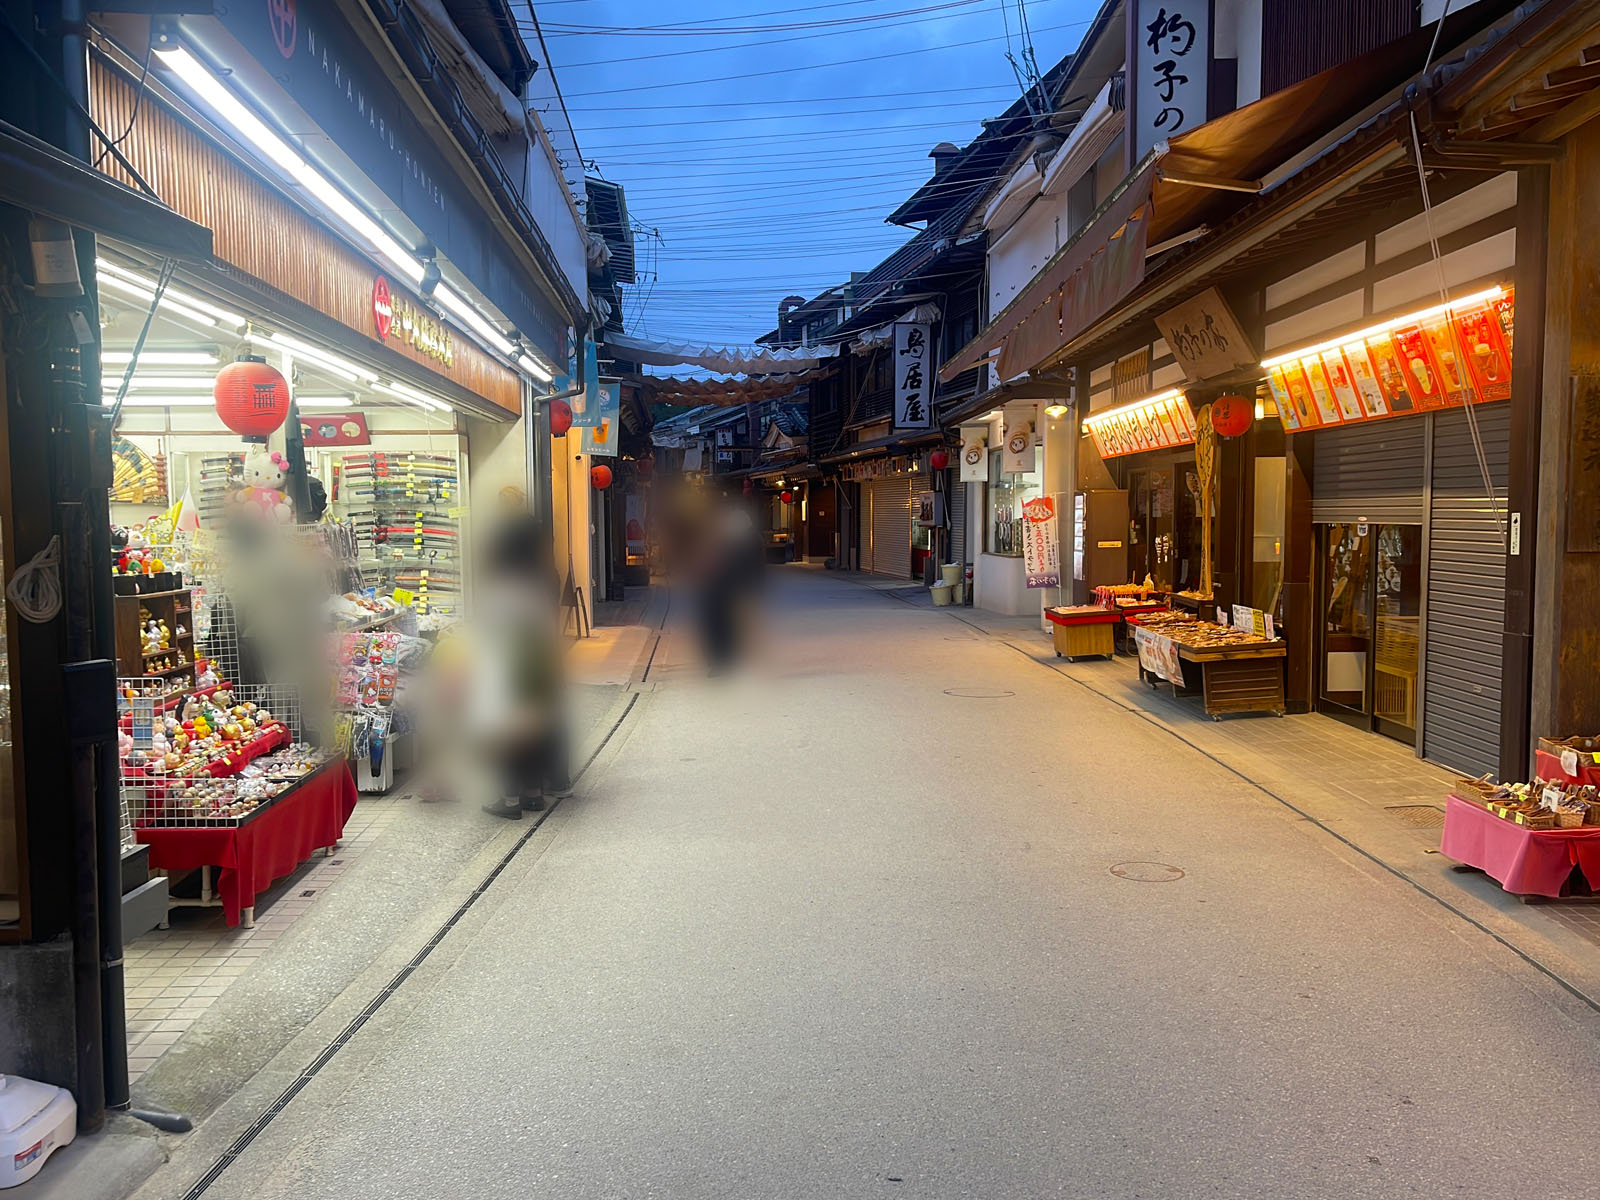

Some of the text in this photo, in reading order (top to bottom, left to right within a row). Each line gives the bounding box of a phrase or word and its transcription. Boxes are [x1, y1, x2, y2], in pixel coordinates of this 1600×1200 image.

[1146, 8, 1196, 132] 杓子の
[899, 328, 925, 423] 鳥居屋
